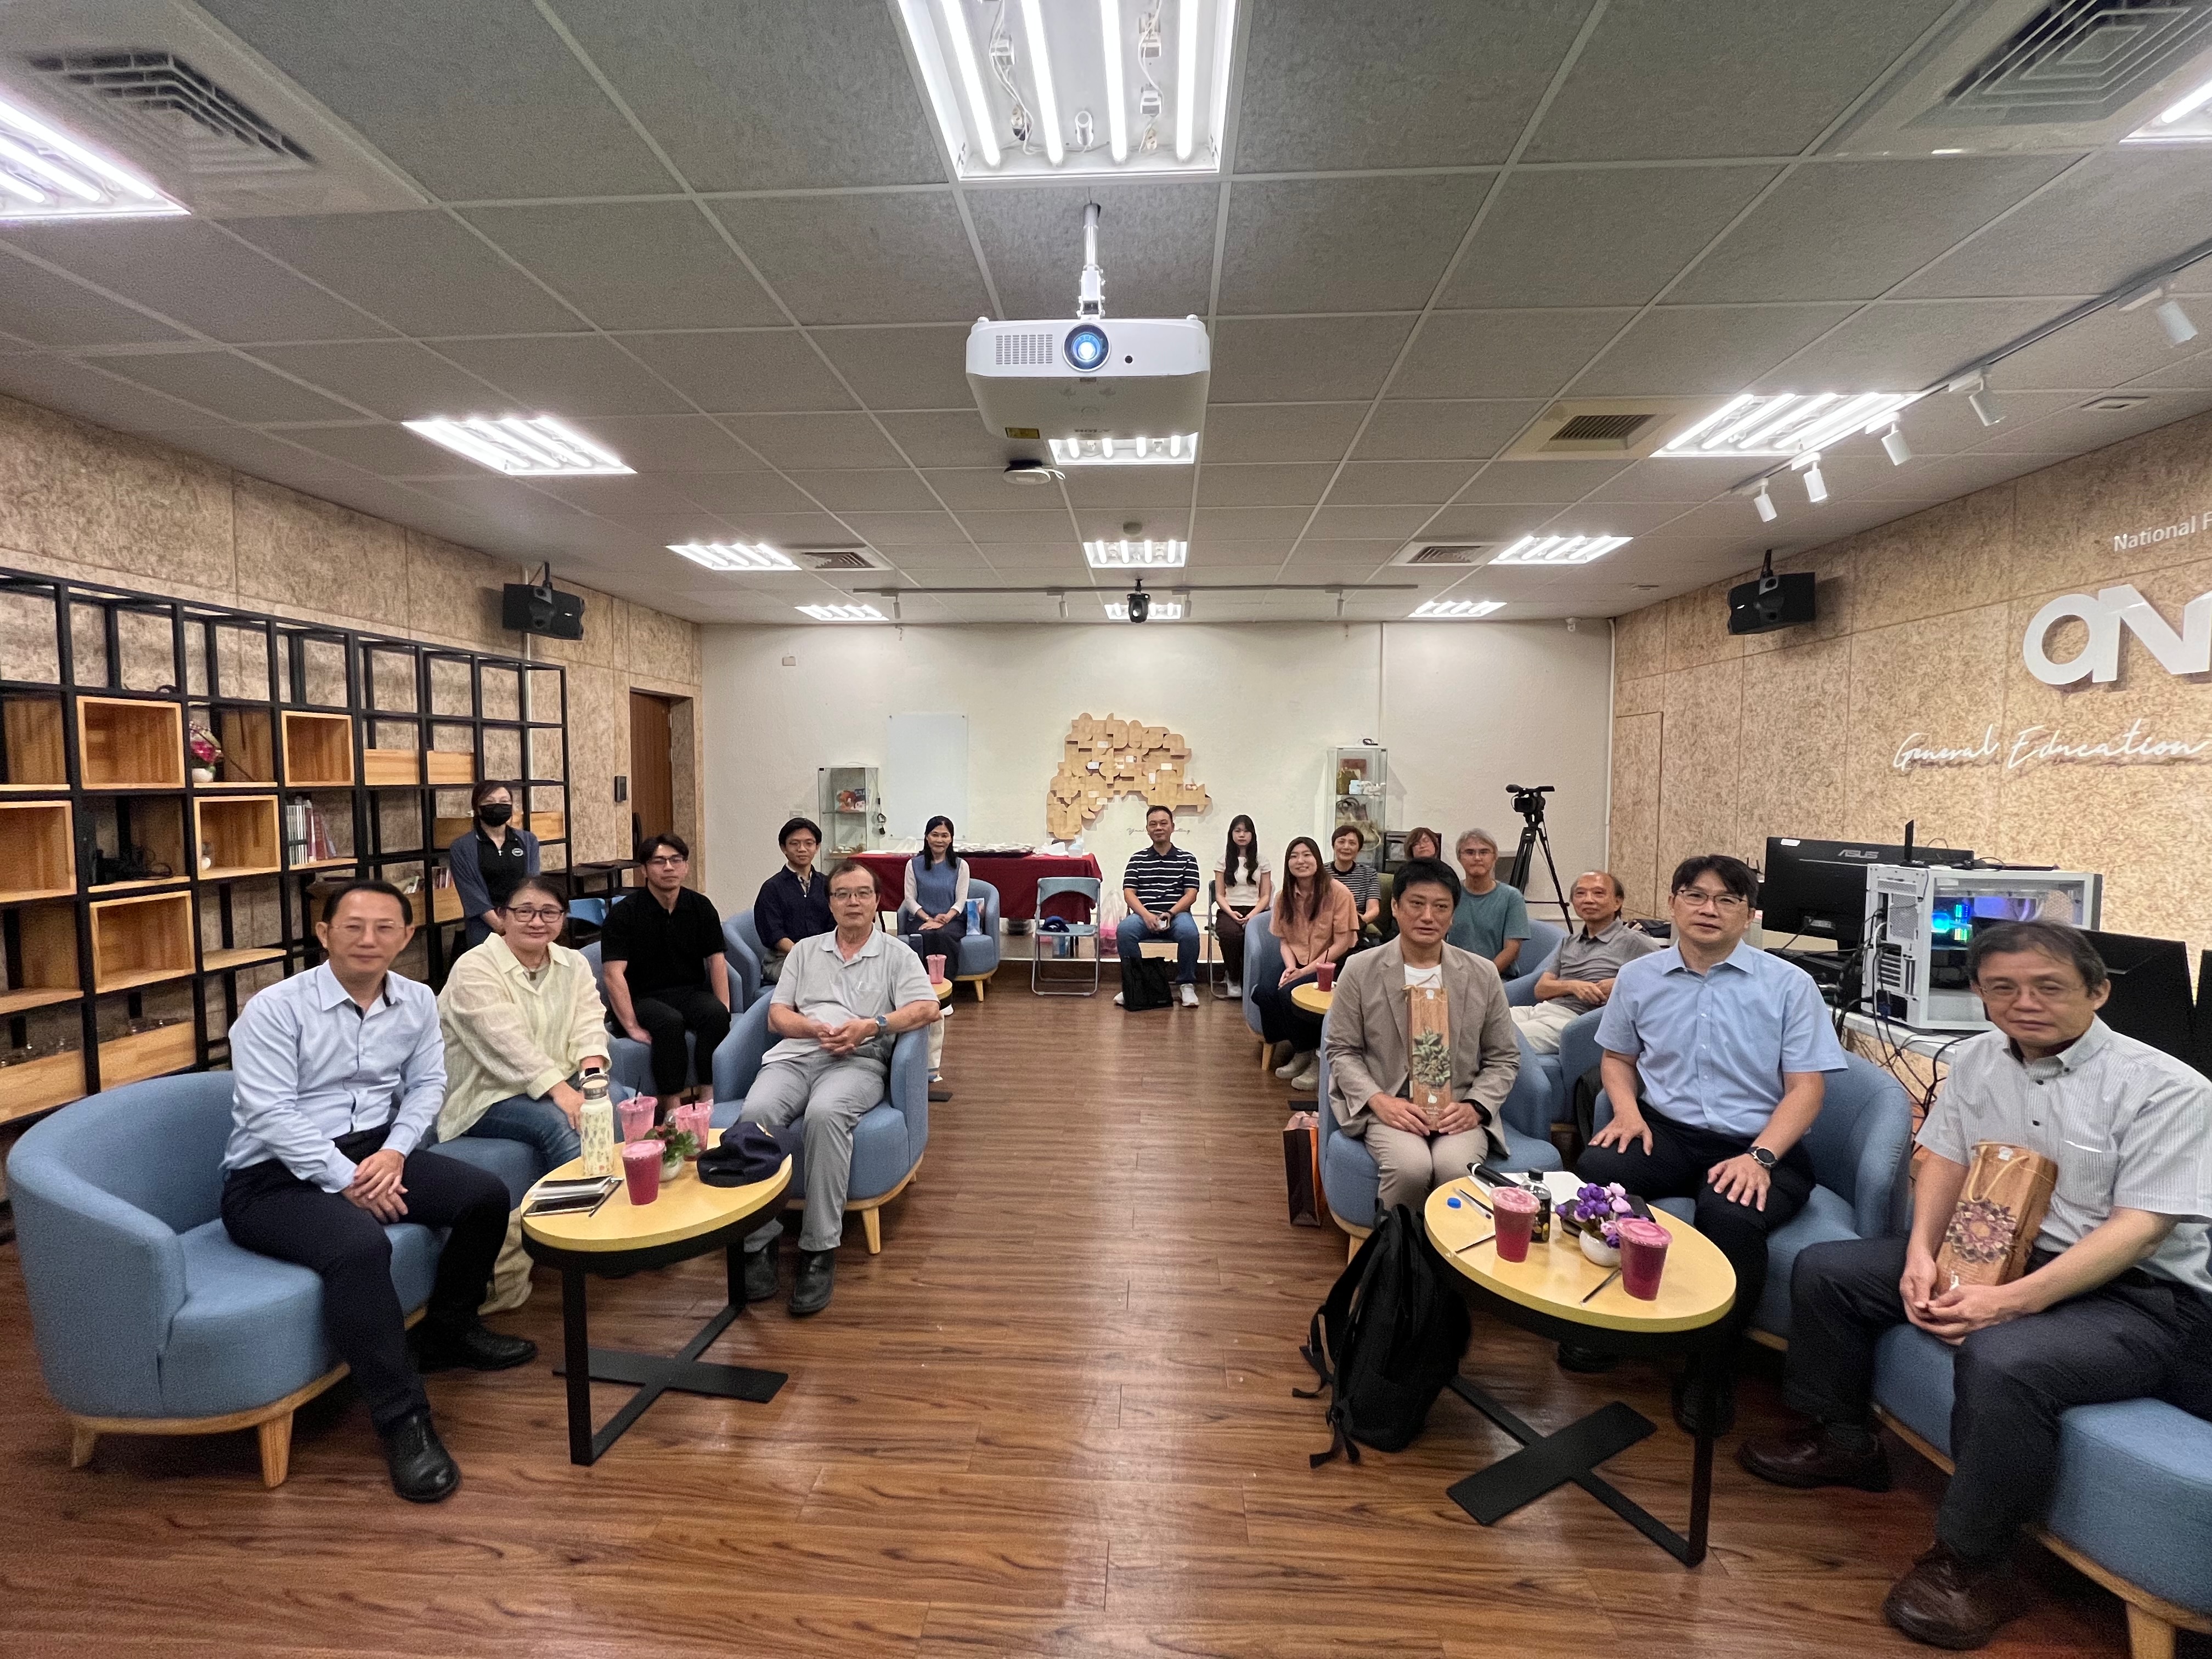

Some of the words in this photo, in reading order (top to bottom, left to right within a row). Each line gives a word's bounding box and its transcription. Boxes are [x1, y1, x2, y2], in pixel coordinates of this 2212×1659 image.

[2114, 515, 2196, 552] National
[1893, 723, 2000, 770] General
[2007, 719, 2211, 769] Education
[1838, 849, 1879, 859] ASUS
